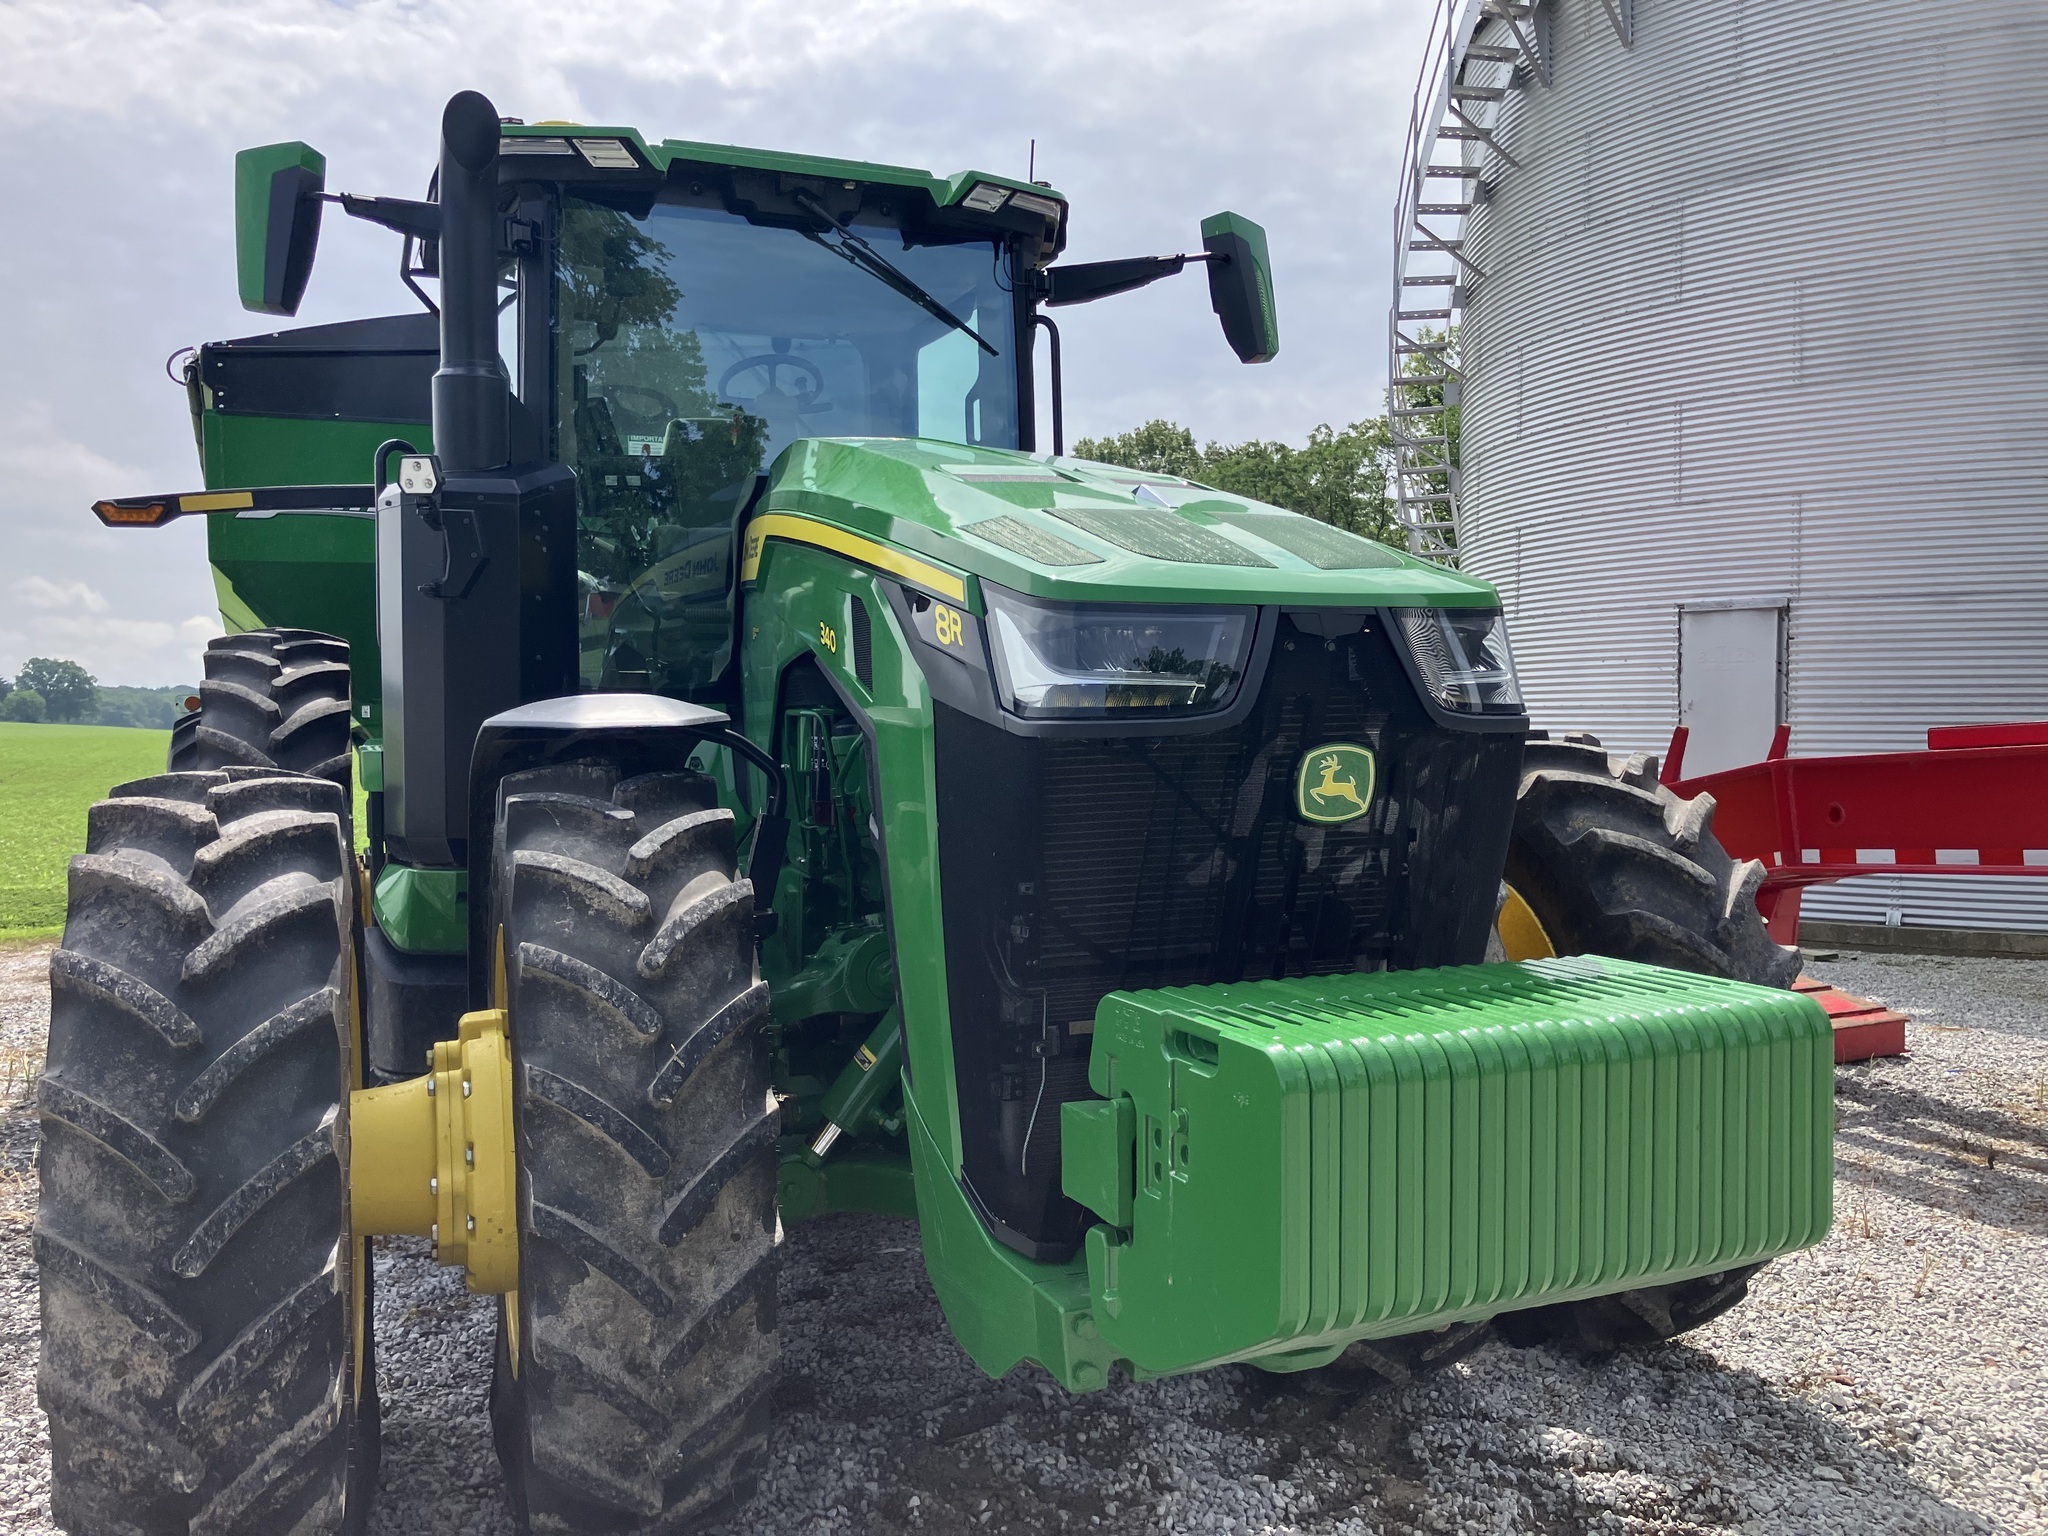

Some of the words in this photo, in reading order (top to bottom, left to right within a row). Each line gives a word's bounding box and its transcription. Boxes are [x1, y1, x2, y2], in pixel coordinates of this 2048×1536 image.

[630, 434, 663, 443] IMPORTA
[819, 621, 837, 654] 340
[934, 604, 964, 646] 8R
